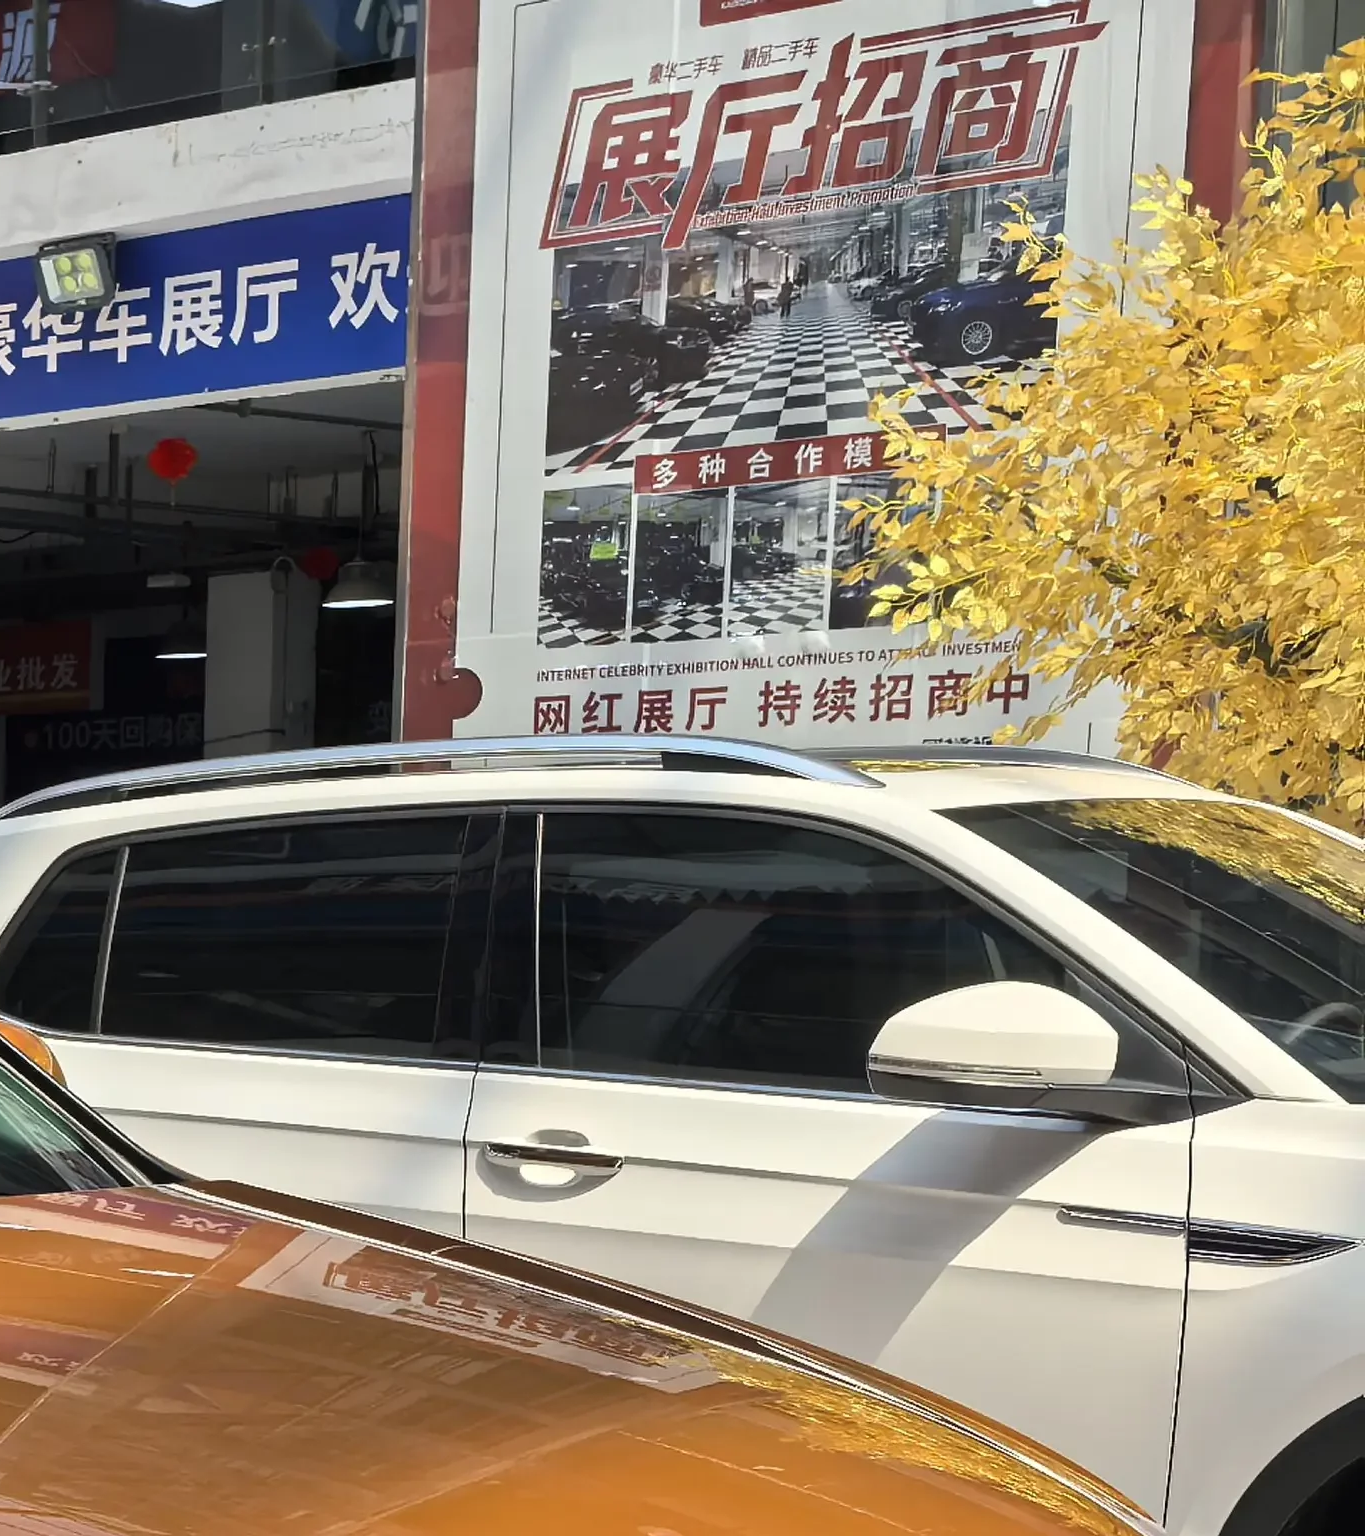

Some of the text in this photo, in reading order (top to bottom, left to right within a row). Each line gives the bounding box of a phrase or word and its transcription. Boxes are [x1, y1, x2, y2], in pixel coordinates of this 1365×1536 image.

[648, 55, 724, 85] 豪华二手车
[566, 21, 1110, 250] 展厅招商
[329, 243, 413, 330] 欢
[652, 436, 919, 490] 多种合作模
[536, 667, 596, 683] INTERNET
[599, 663, 665, 679] CELEBRITY
[666, 659, 738, 676] EXHIBITION
[742, 655, 773, 669] HALL
[777, 651, 854, 668] CONTINUES
[858, 649, 874, 662] TO
[942, 640, 1023, 657] INVESTMEN
[534, 668, 1030, 735] 网红展厅 持续招商中
